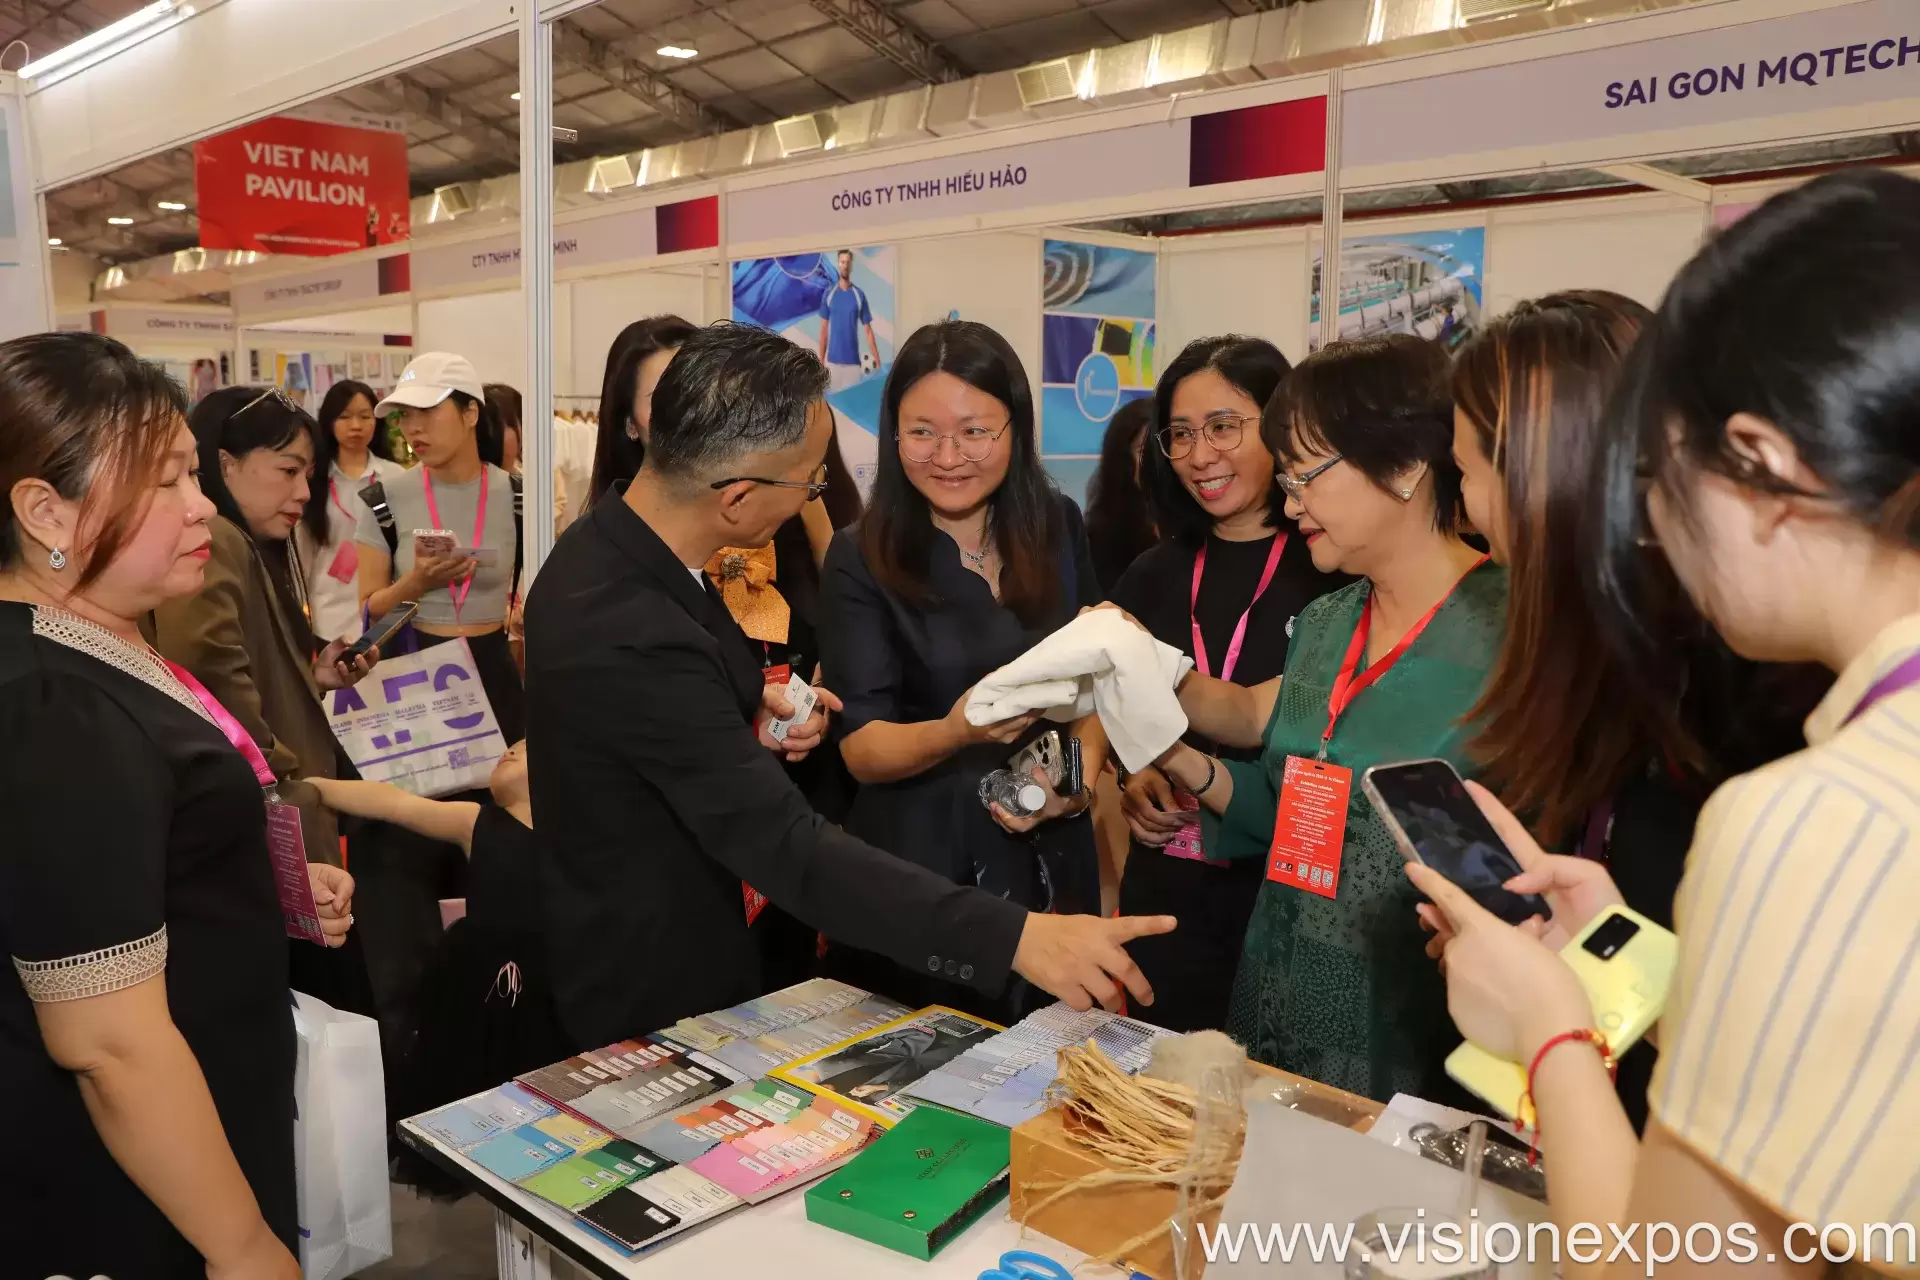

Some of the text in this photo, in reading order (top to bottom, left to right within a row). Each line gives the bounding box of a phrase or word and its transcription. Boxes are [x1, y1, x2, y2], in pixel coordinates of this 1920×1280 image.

[1604, 36, 1920, 109] SAI GON MQTECH
[243, 140, 370, 177] VIET NAM
[245, 173, 366, 207] PAVILION
[832, 164, 1027, 211] CÔNG TY TNHH HIẾU HẢO
